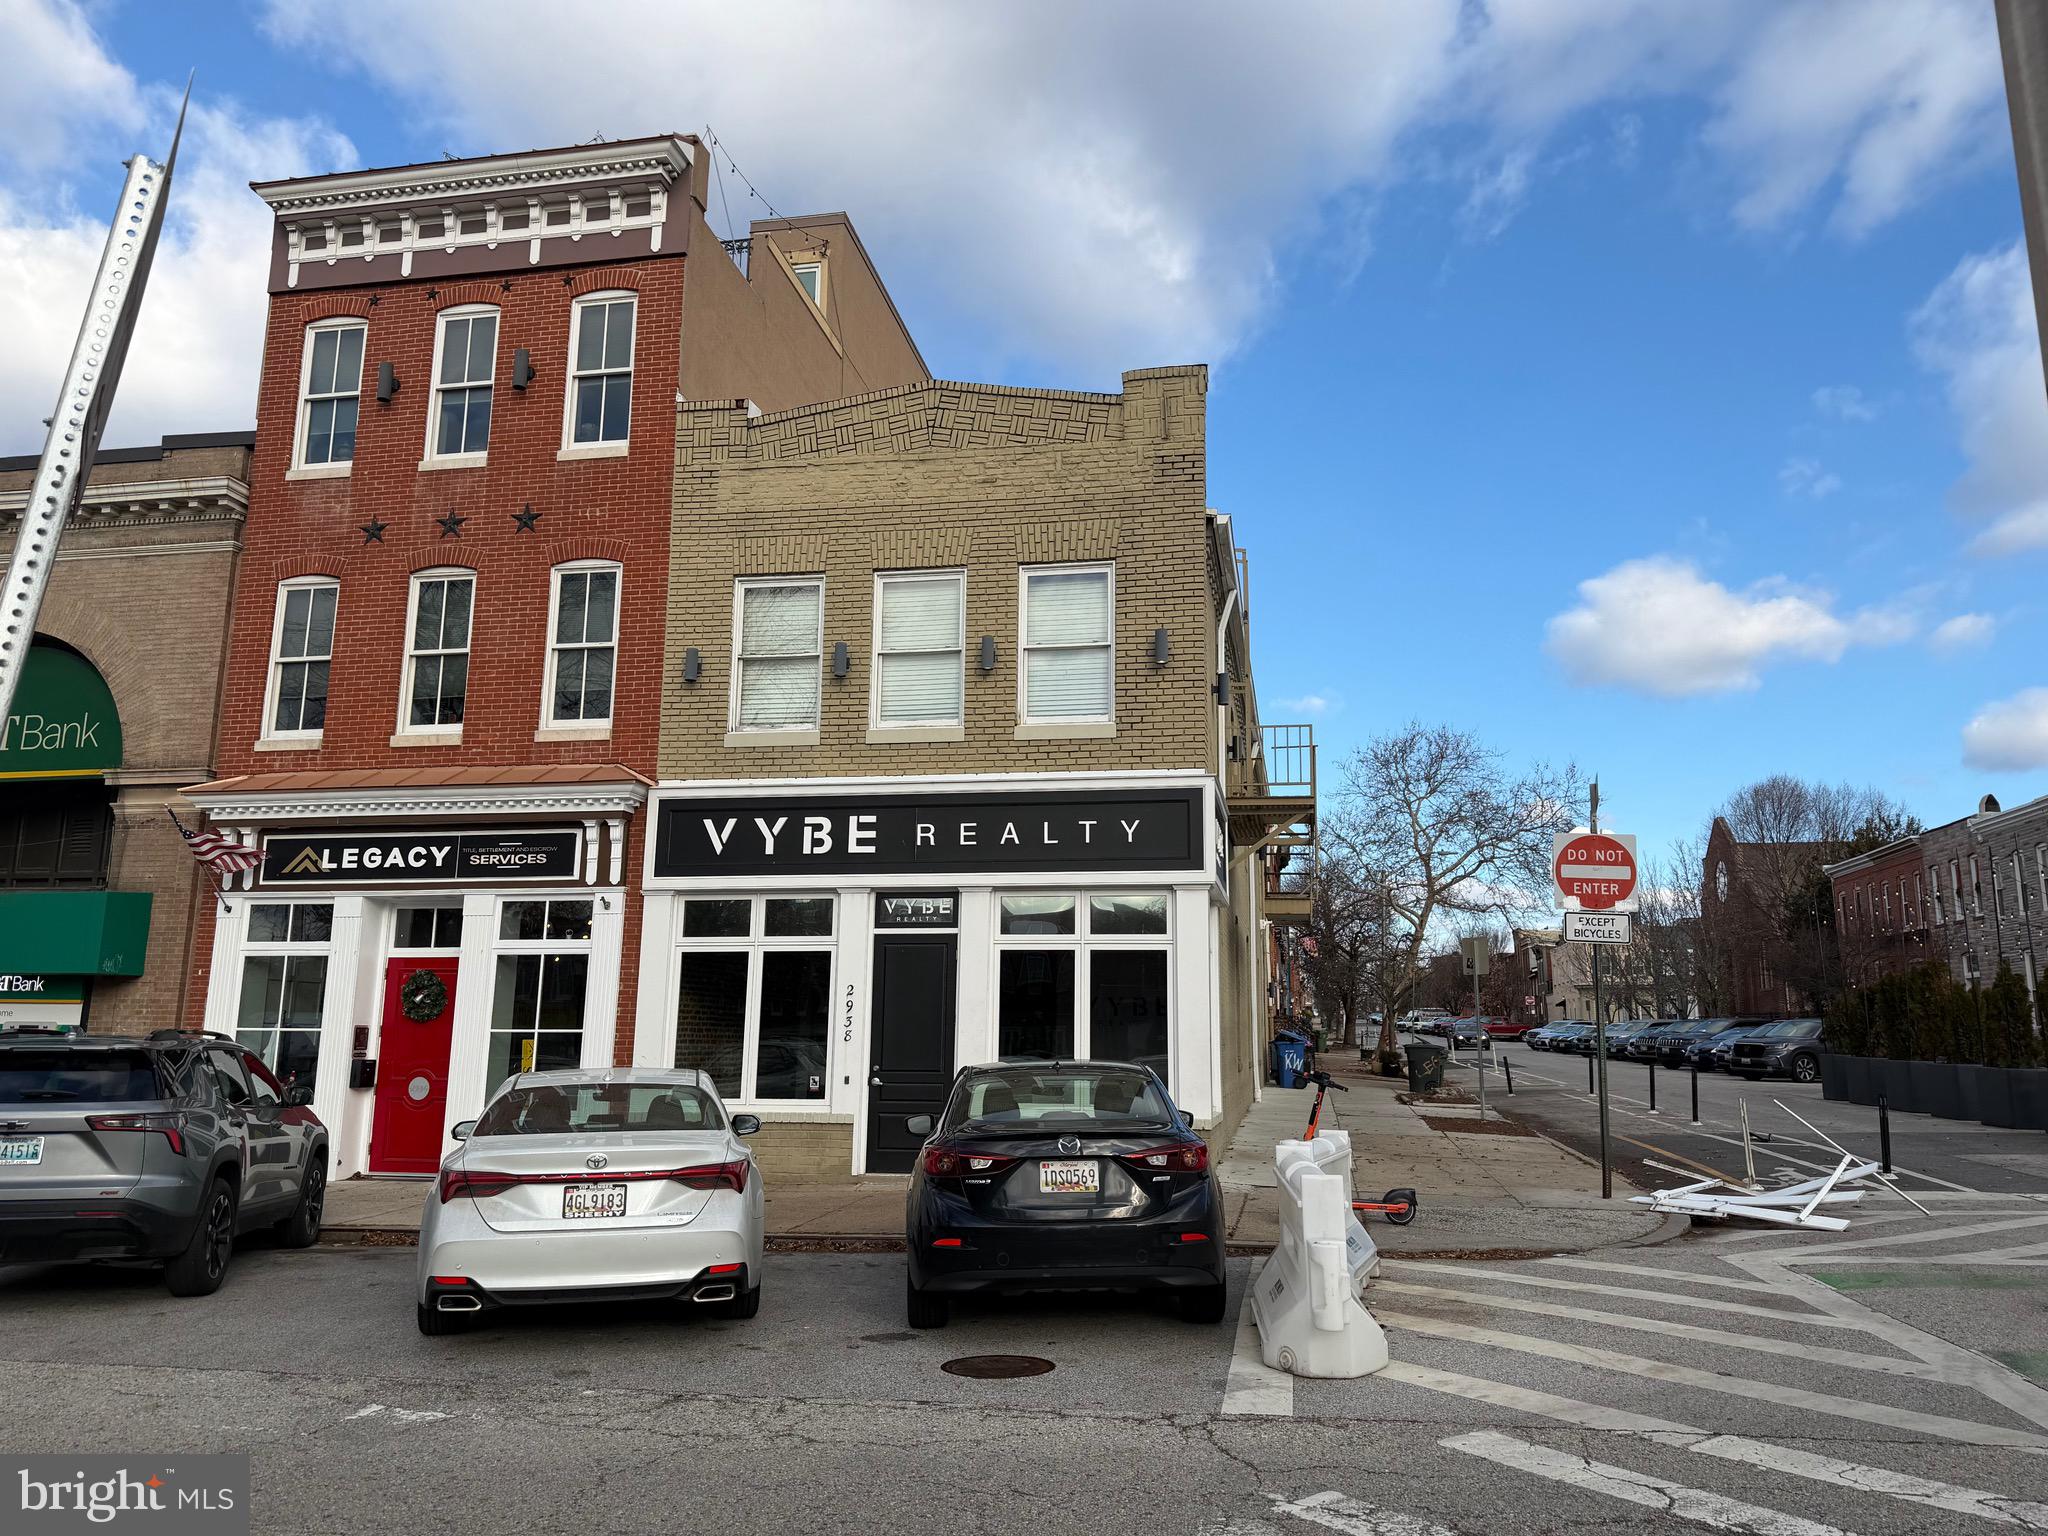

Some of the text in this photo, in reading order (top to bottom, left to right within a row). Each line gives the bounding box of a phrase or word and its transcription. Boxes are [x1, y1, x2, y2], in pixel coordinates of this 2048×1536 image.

[20, 712, 100, 751] Bank
[702, 815, 1140, 856] VYBE REALTY
[321, 846, 452, 869] LEGACY
[469, 853, 547, 865] SERVICES
[1567, 849, 1624, 862] DO NOT
[1573, 882, 1620, 896] ENTER
[884, 898, 951, 914] VYBE
[1578, 916, 1616, 927] EXCEPT
[1573, 928, 1621, 939] BICYCLES
[12, 975, 44, 992] Bank
[843, 984, 854, 1042] 2938
[1044, 1169, 1096, 1187] 1DS0569
[566, 1193, 624, 1210] 4GL9183
[564, 1210, 624, 1219] SHEEHY
